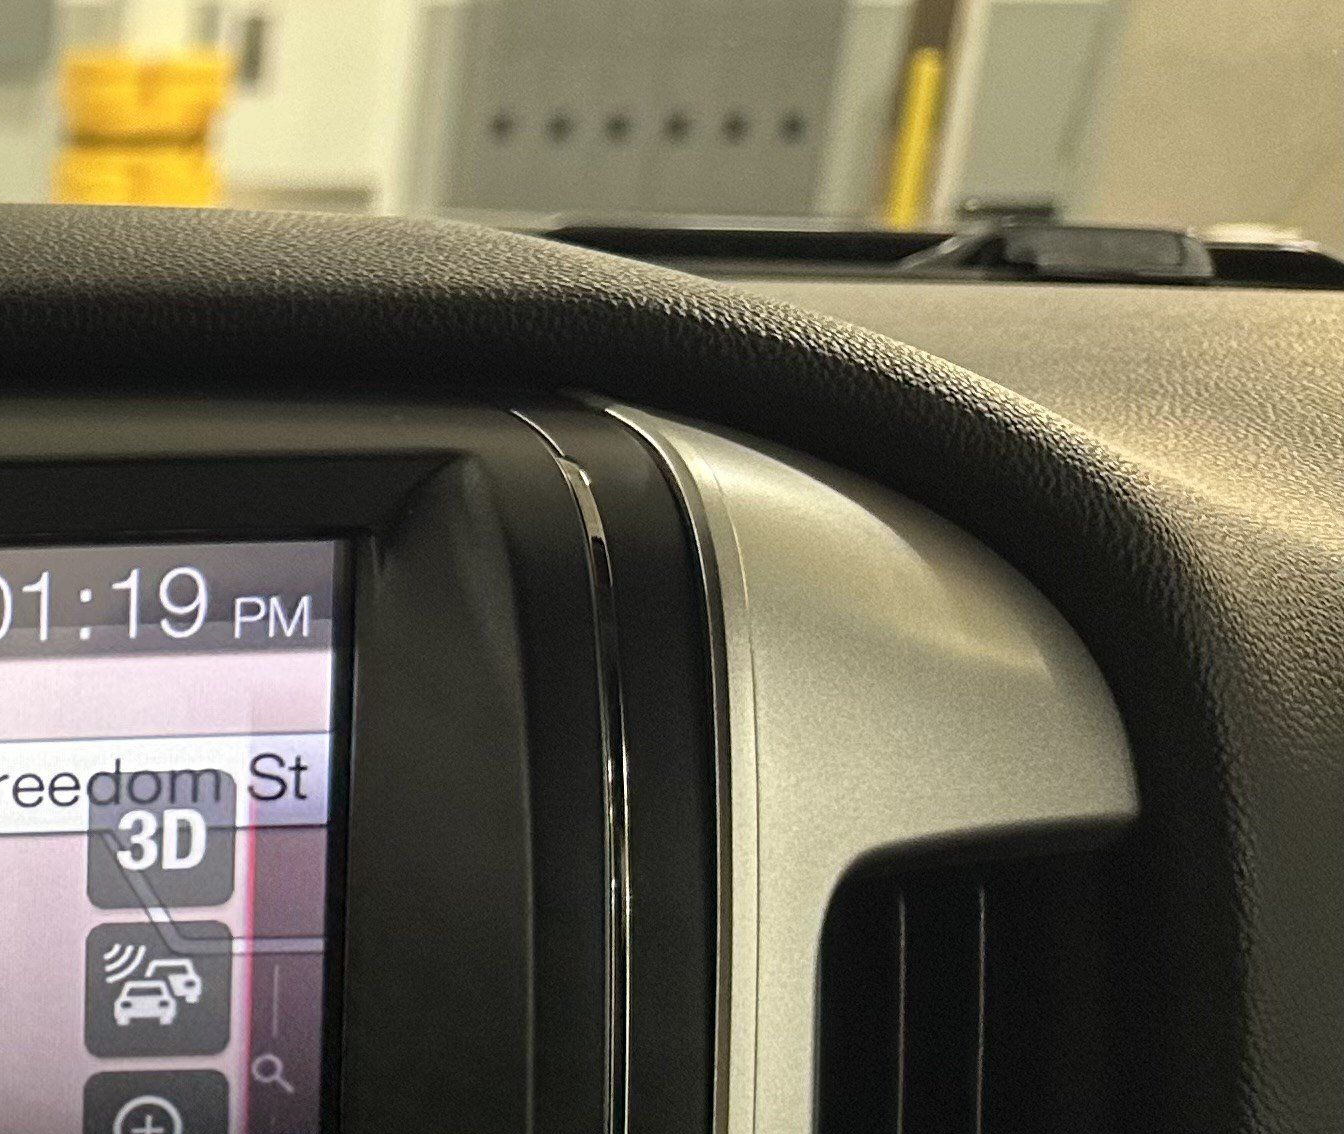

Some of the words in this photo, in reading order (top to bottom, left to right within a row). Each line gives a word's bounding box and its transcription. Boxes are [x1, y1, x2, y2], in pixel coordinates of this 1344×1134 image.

[232, 595, 312, 639] PM
[246, 751, 309, 803] St
[115, 808, 208, 872] 3D
